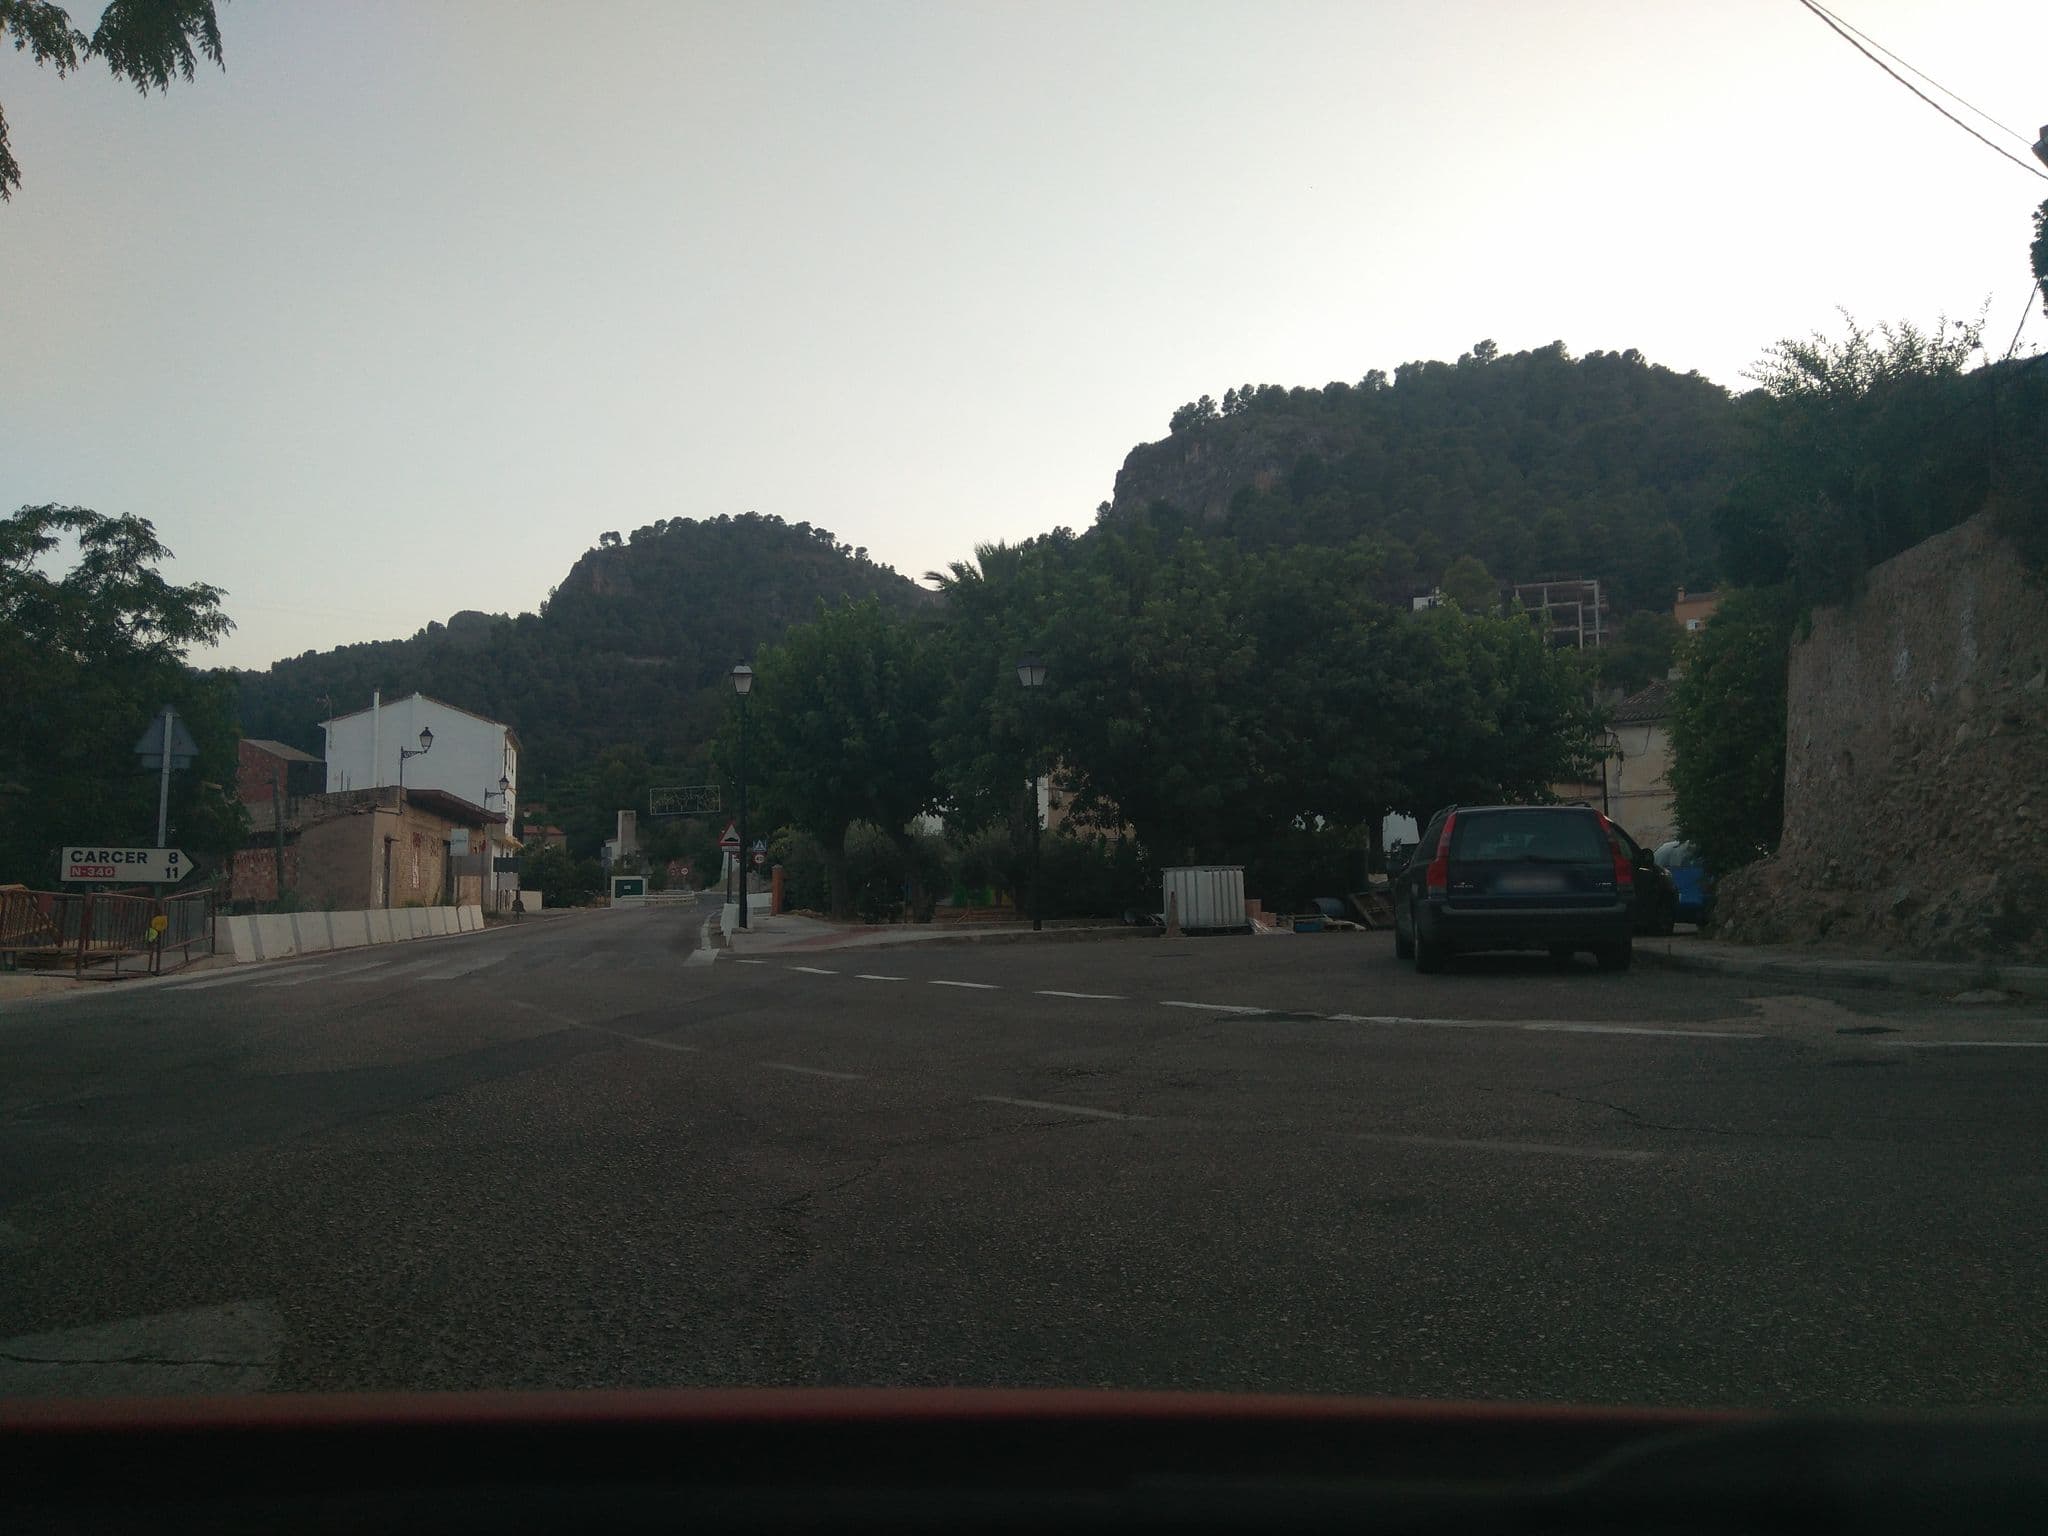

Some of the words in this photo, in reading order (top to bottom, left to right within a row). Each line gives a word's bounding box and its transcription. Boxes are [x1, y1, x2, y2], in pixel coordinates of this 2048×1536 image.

[70, 850, 148, 864] CARCER
[168, 851, 179, 864] 8
[71, 866, 115, 877] N-340
[164, 866, 179, 879] 11
